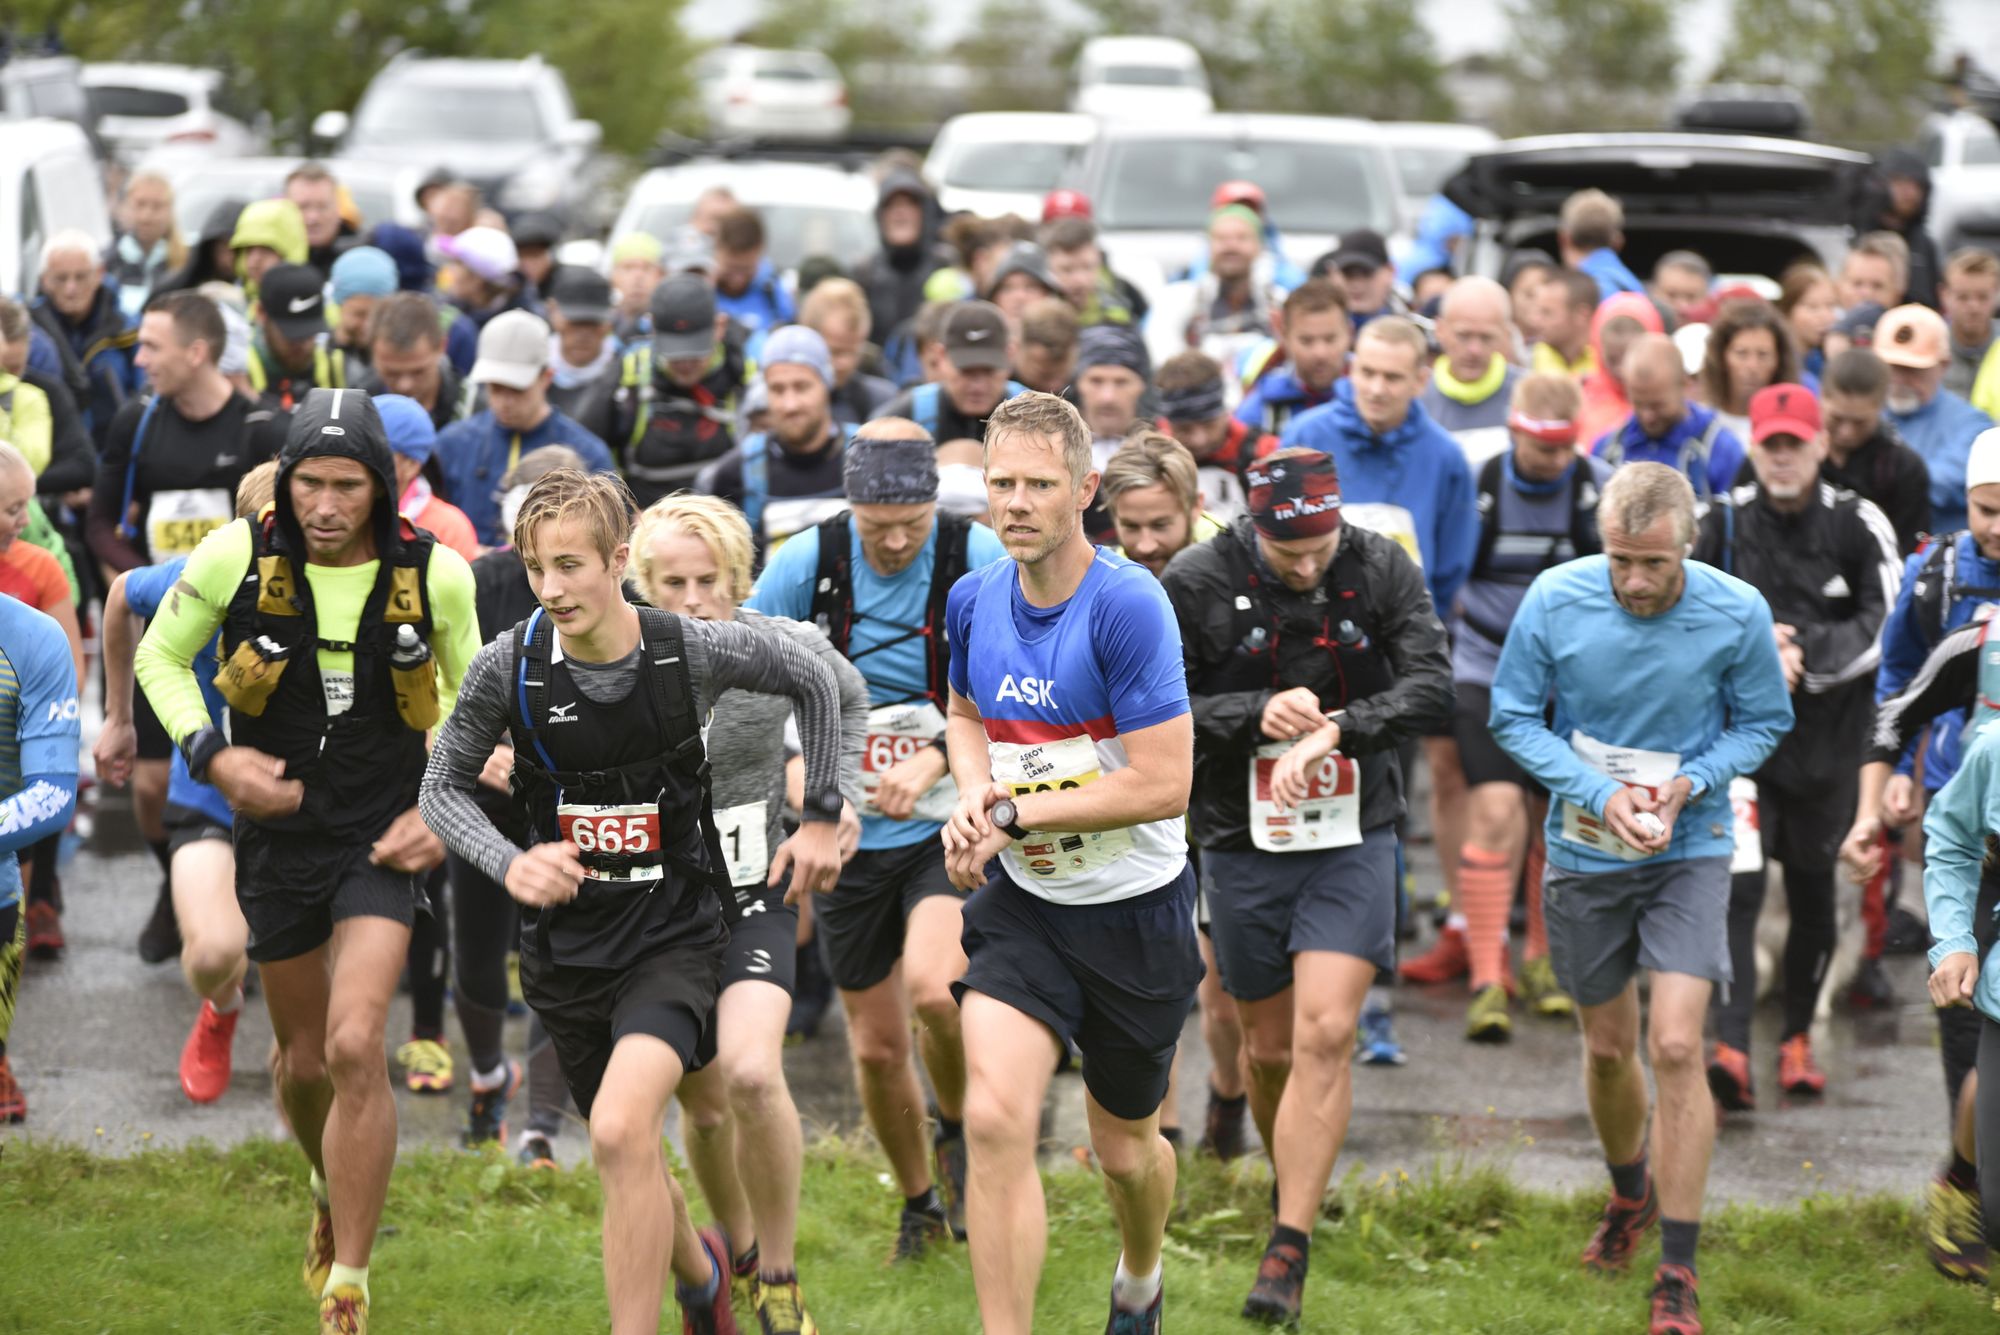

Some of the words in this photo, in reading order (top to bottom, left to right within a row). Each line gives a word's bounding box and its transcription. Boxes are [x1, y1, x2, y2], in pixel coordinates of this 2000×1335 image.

[267, 576, 285, 598] G
[395, 589, 411, 611] G
[996, 673, 1059, 709] ASK
[870, 736, 930, 773] 69
[1026, 762, 1054, 779] LANGS
[571, 817, 650, 854] 665
